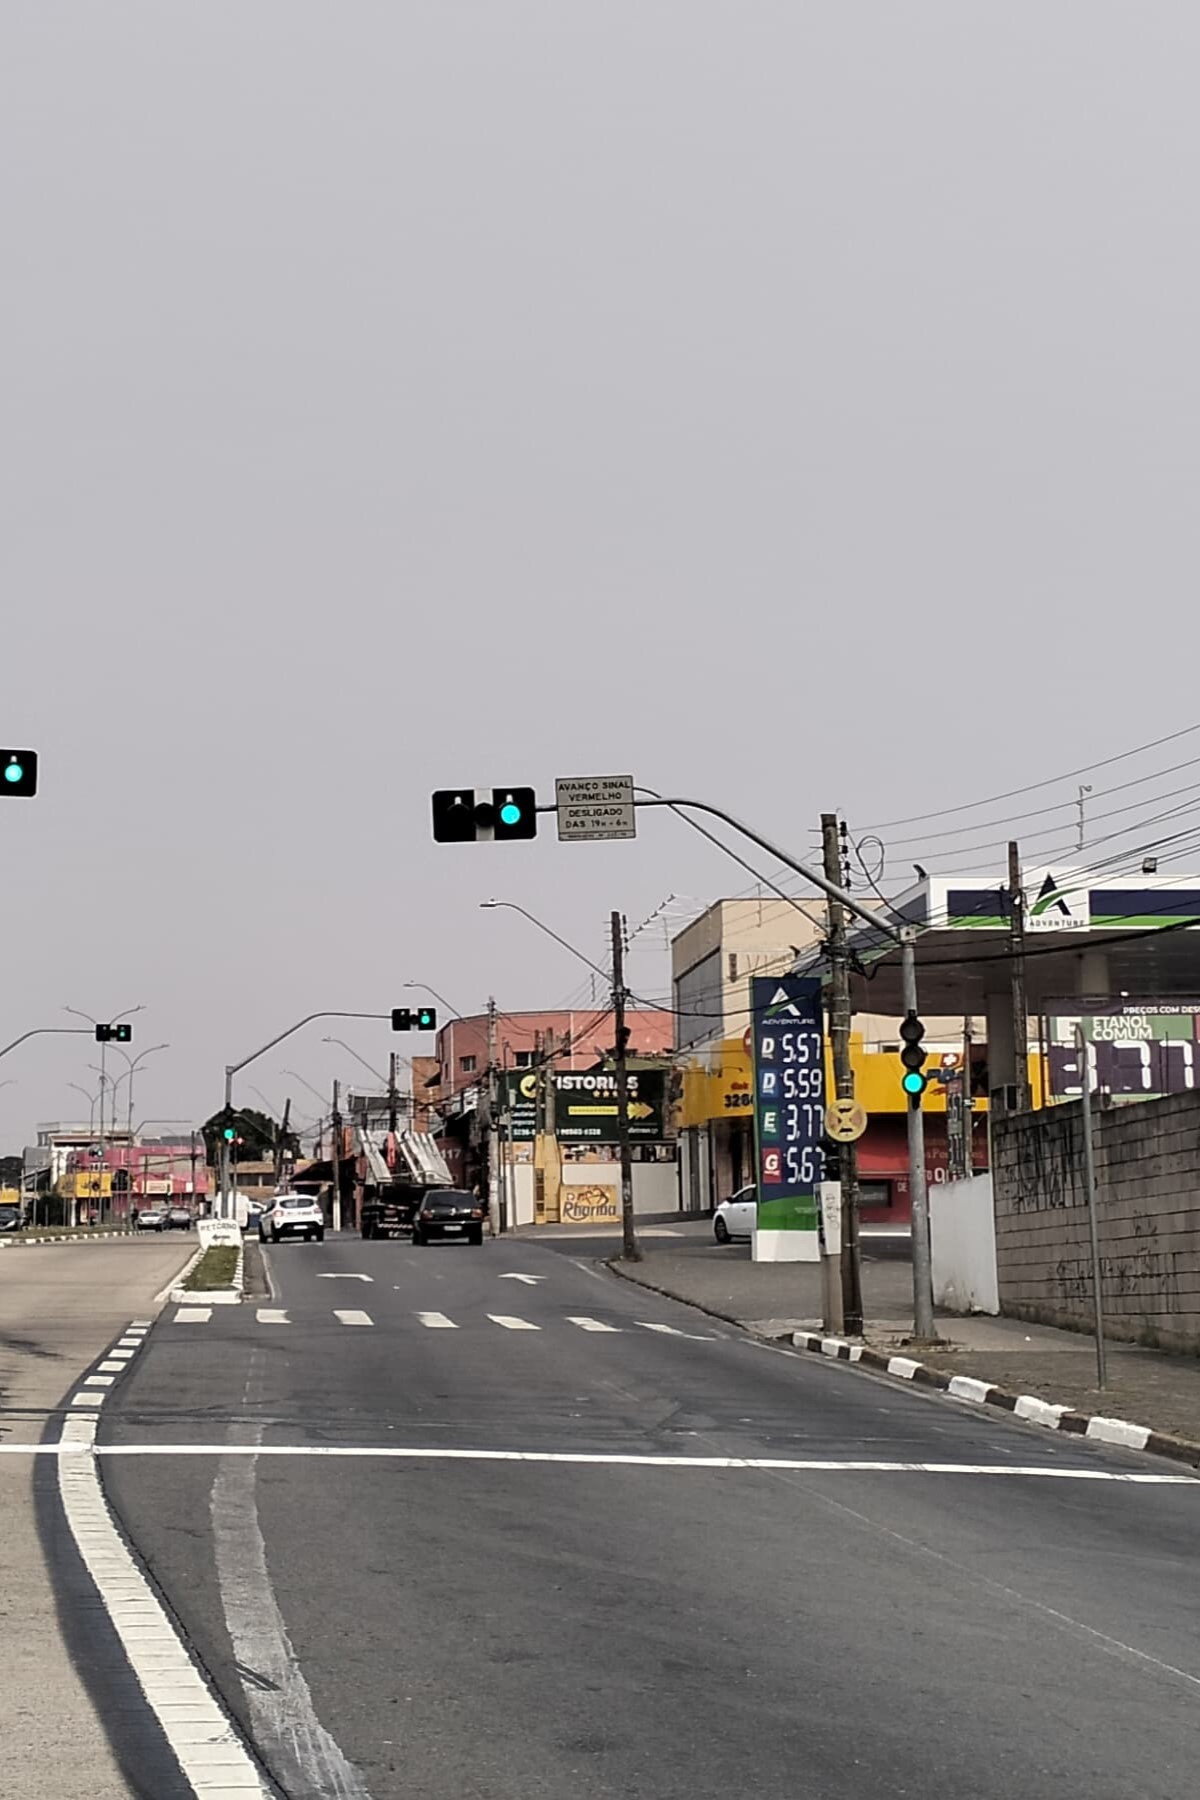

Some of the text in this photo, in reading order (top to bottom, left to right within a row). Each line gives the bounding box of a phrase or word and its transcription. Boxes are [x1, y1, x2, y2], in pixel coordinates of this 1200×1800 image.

[558, 781, 631, 791] AVANÇO SINAL
[568, 792, 622, 801] VERMELHO
[569, 808, 623, 817] DESLIGADO
[565, 820, 586, 828] DAS
[1123, 1006, 1158, 1015] PREÇOS
[1159, 1006, 1179, 1014] COM
[1092, 1016, 1152, 1029] ETANOL
[1092, 1028, 1153, 1040] COMUM
[761, 1037, 775, 1054] D
[762, 1068, 822, 1098] D 5,59
[763, 1111, 777, 1129] E
[765, 1154, 779, 1170] G
